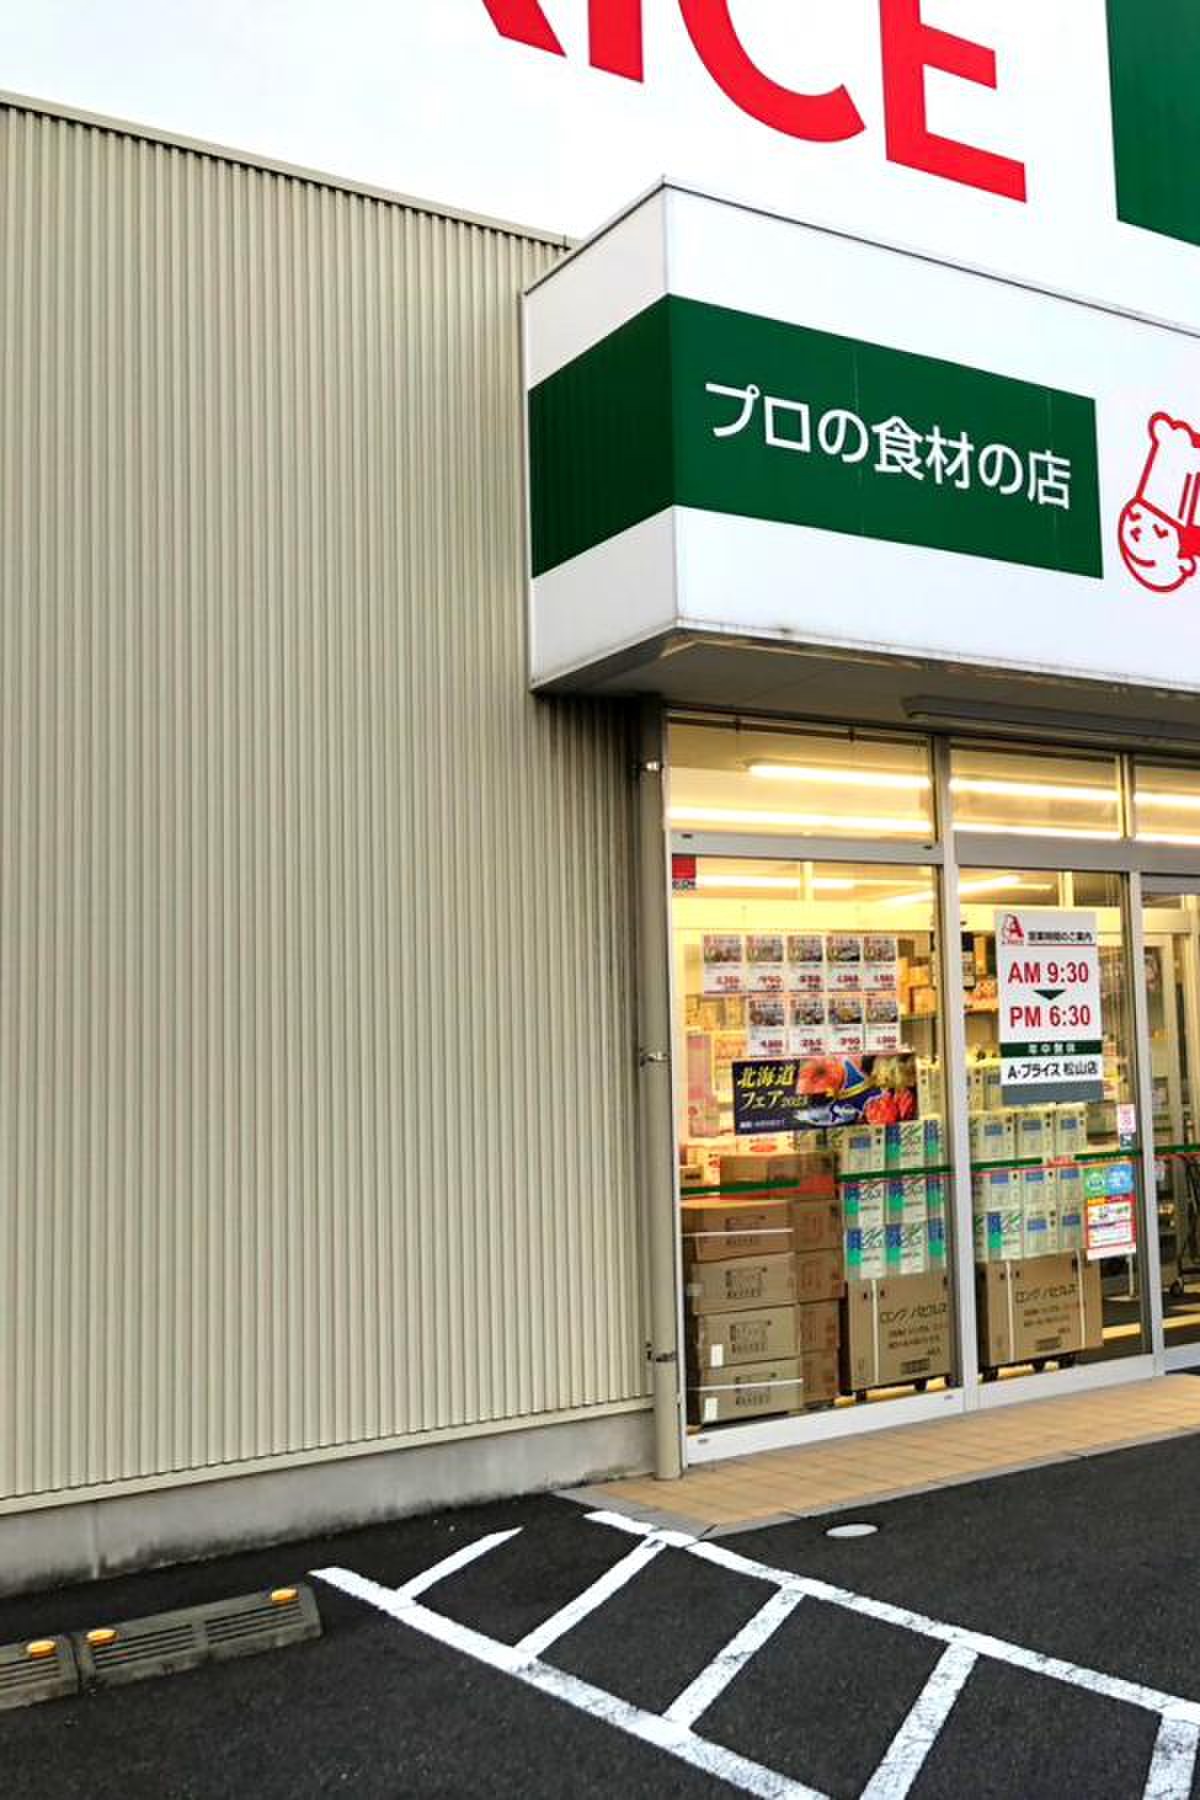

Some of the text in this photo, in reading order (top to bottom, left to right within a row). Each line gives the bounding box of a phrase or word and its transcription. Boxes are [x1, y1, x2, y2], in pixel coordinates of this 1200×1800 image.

[704, 381, 1072, 511] プロの食材の店
[1007, 961, 1089, 984] AM 9:30
[1010, 1005, 1091, 1028] PM 6:30
[737, 1063, 797, 1089] 北海道
